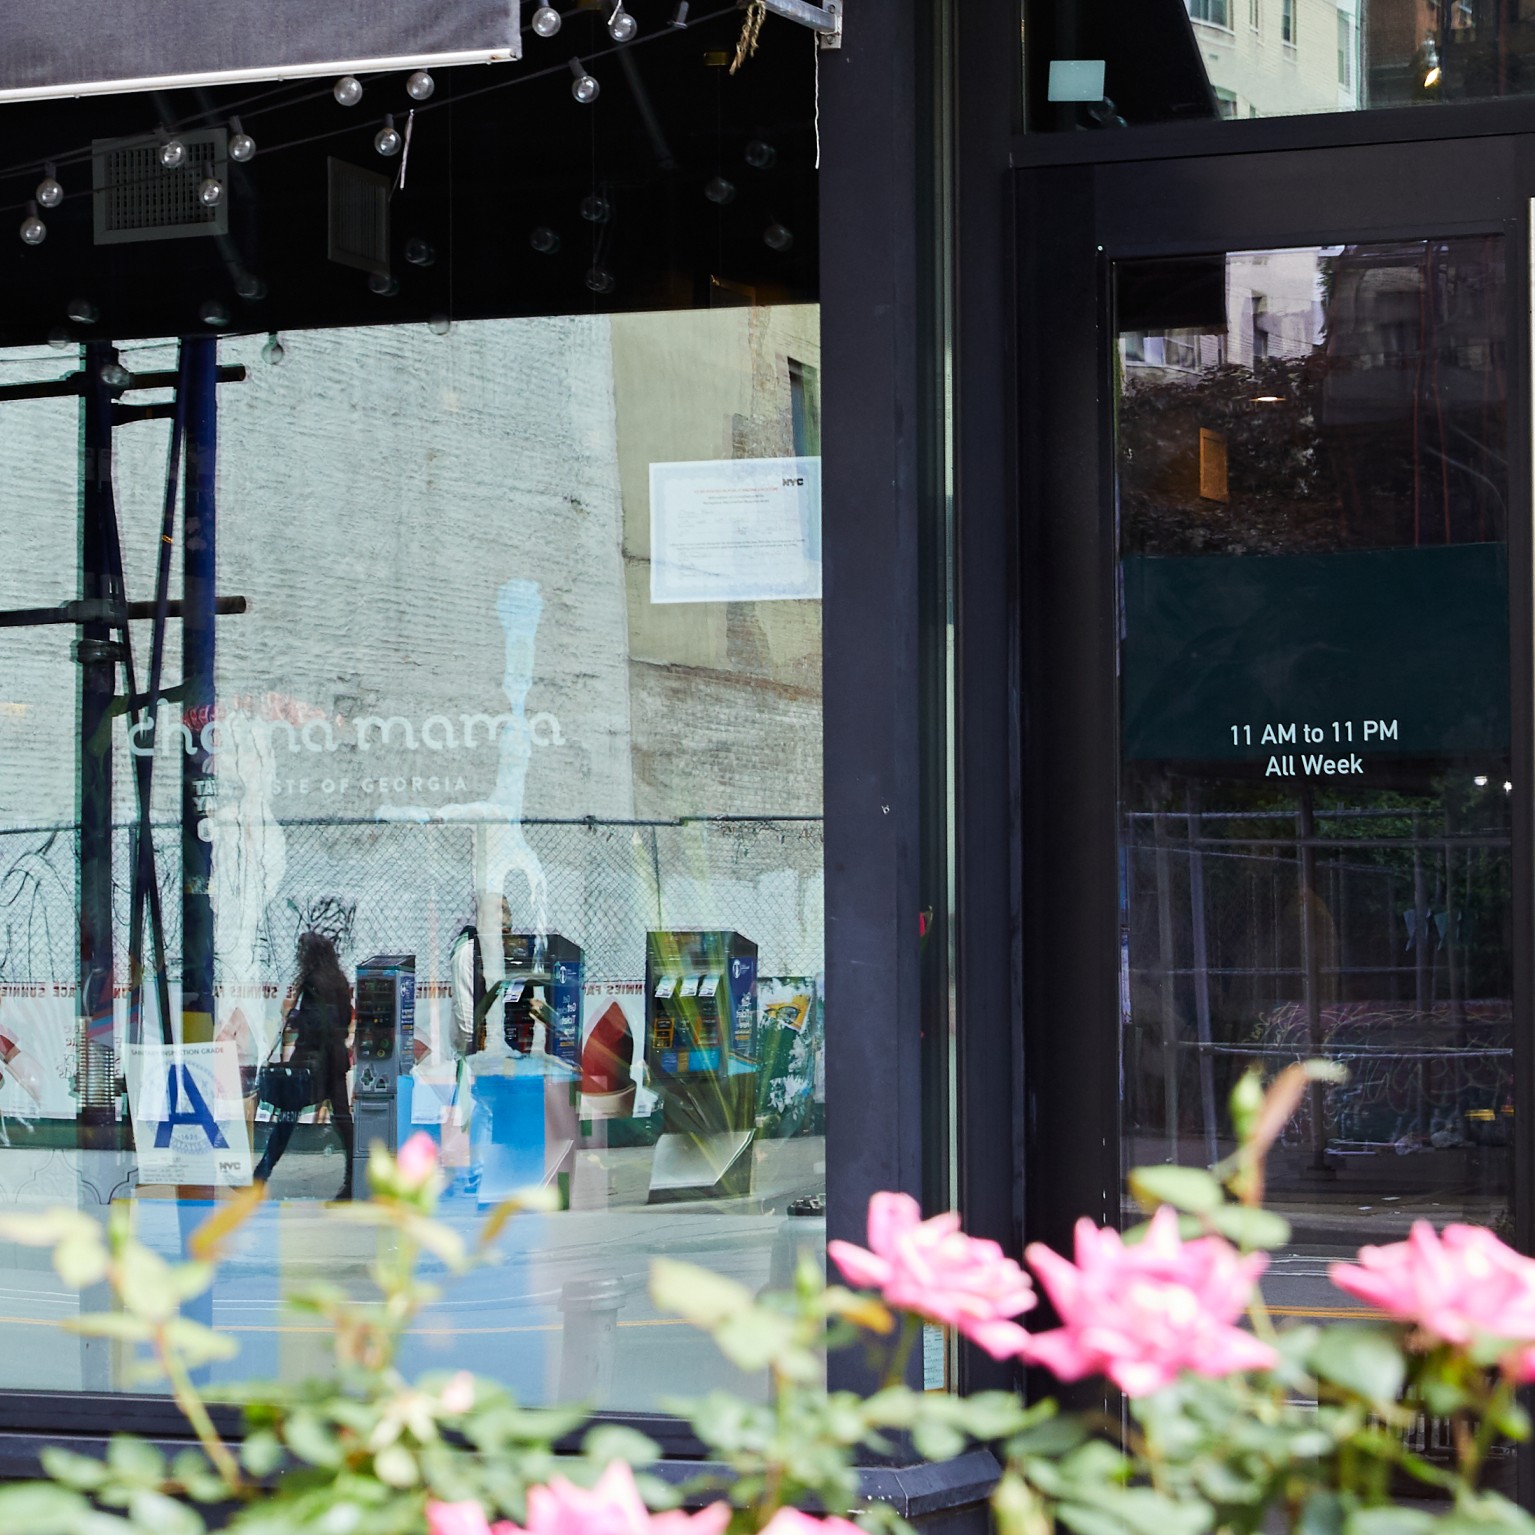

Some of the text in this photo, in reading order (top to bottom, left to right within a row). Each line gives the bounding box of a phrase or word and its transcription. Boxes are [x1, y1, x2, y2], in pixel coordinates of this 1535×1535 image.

[782, 478, 804, 486] NYC
[352, 711, 566, 752] mama
[1230, 719, 1399, 746] 11 AM to 11 PM
[1265, 753, 1364, 777] All Week
[321, 778, 347, 794] OF
[361, 775, 468, 794] GEORGIA
[163, 1047, 199, 1057] INSPTION
[201, 1046, 224, 1056] GRADE
[154, 1064, 230, 1149] A
[219, 1161, 241, 1171] NYC
